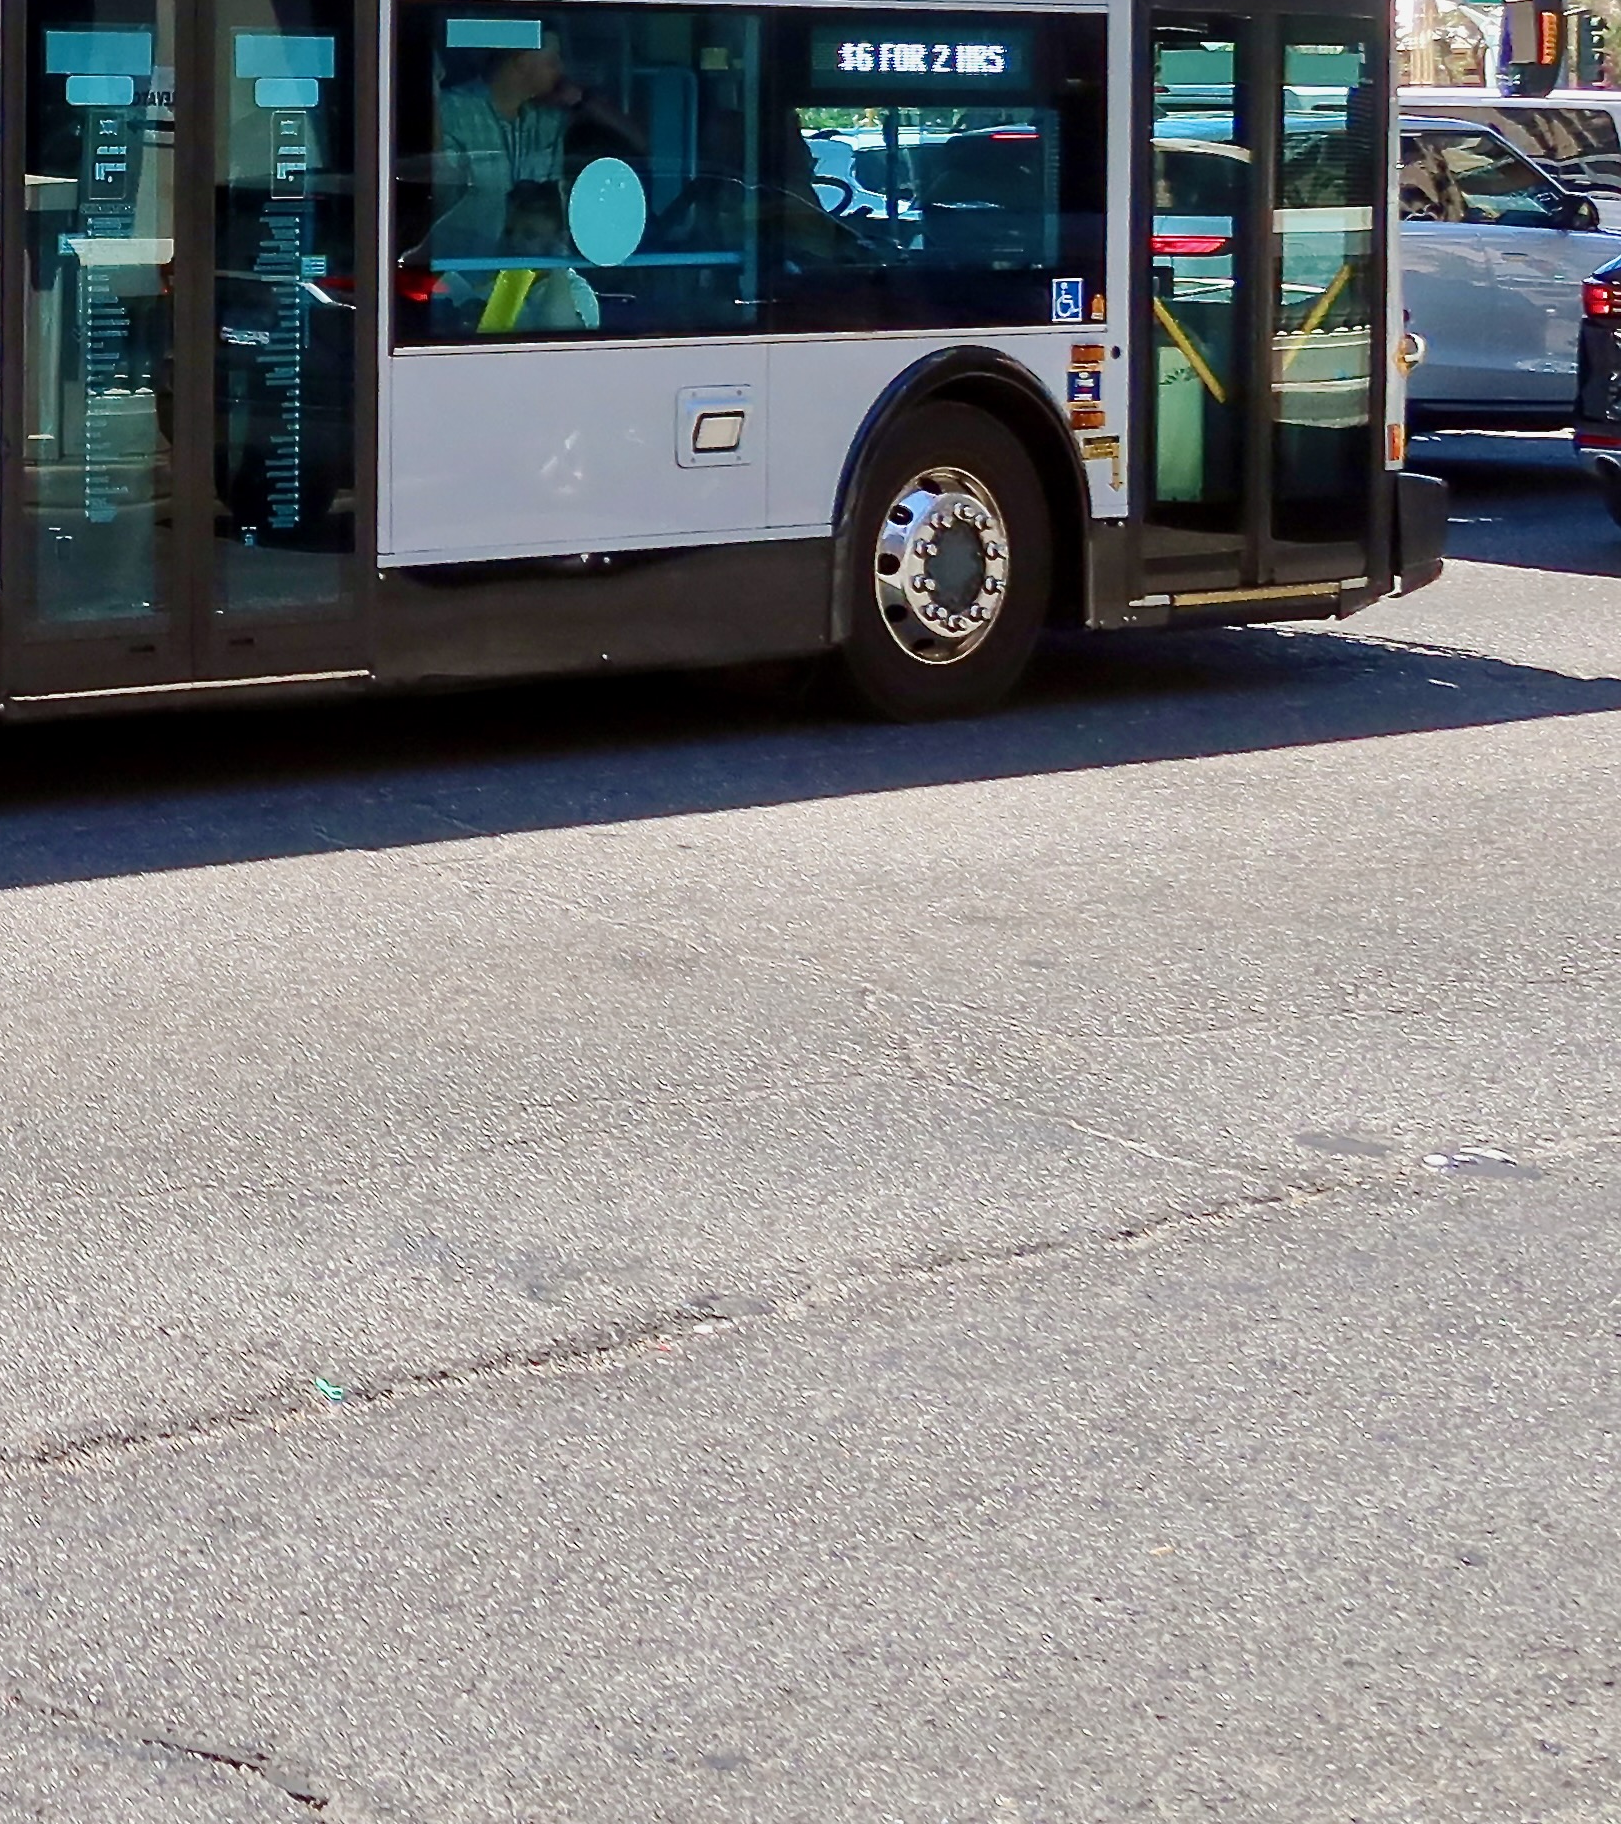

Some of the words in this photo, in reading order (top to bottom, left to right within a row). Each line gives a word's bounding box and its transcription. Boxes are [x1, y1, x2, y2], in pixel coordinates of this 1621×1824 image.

[878, 43, 928, 73] FOR
[930, 44, 953, 73] 2
[955, 44, 1006, 74] HRS
